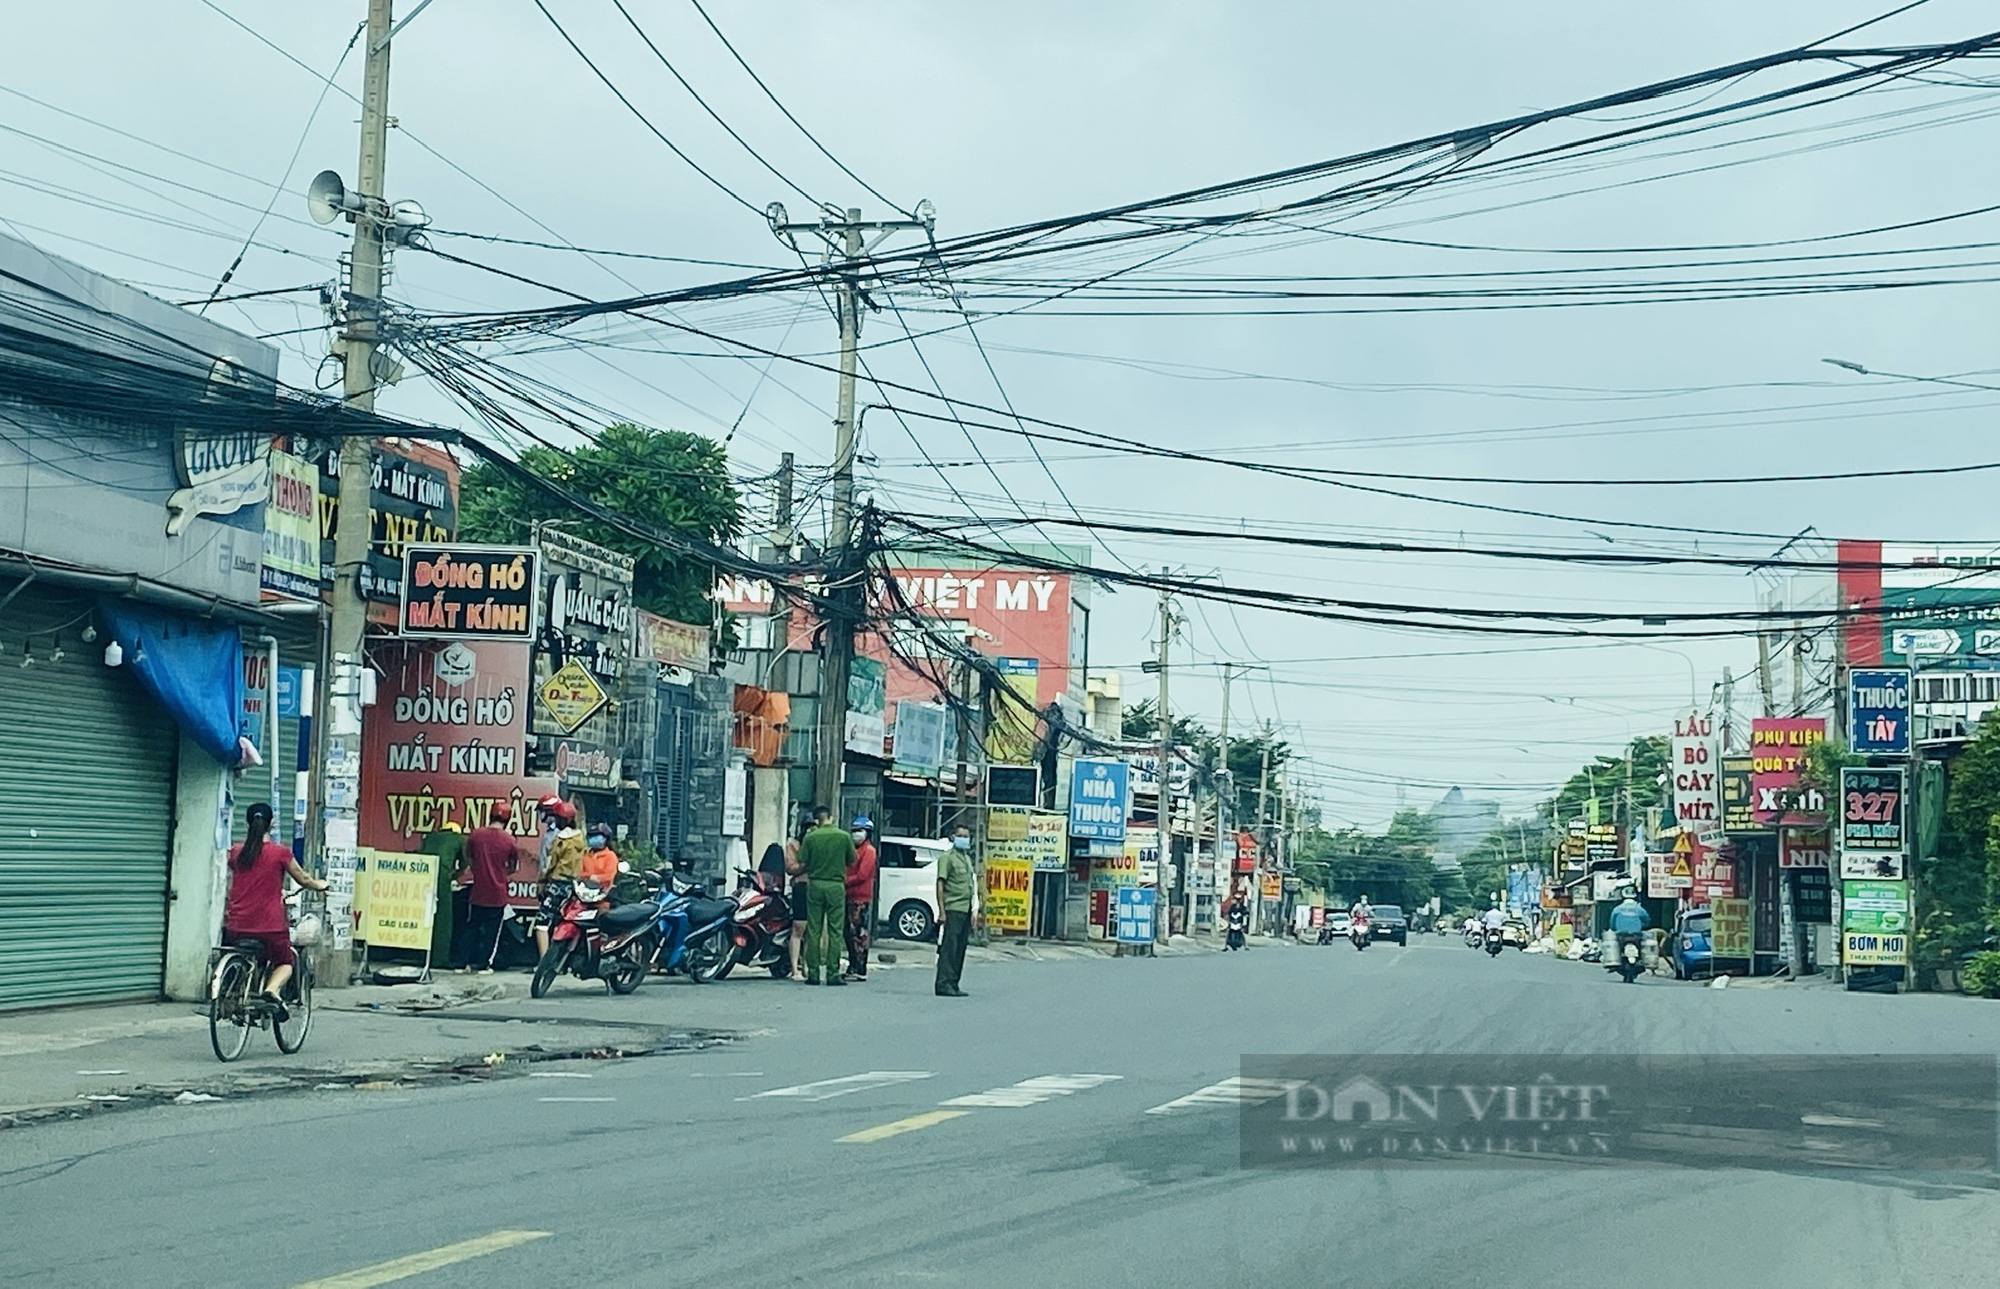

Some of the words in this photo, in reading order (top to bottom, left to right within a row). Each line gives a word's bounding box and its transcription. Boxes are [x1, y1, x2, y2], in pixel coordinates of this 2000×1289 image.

[391, 462, 416, 500] MẮT
[417, 473, 445, 509] KÍNH
[415, 552, 484, 589] ĐỒNG
[489, 554, 527, 591] HỒ
[898, 573, 985, 614] VIỆT
[995, 574, 1057, 612] MỸ
[408, 590, 461, 629] MẮT
[465, 597, 528, 631] KÍNH
[602, 591, 628, 634] CÁO
[395, 686, 469, 725] ĐỒNG
[475, 687, 515, 726] HỒ
[1856, 677, 1906, 709] THUỐC
[1754, 730, 1784, 748] PHỤ
[1865, 714, 1898, 742] TÂY
[388, 733, 443, 772] MẮT
[450, 738, 516, 775] KÍNH
[1683, 741, 1709, 765] BÒ
[1753, 756, 1783, 774] QUÀ
[1082, 777, 1116, 799] NHÀ
[1676, 769, 1715, 791] CÂY
[387, 783, 455, 839] VIỆT
[1073, 800, 1122, 824] THUỐC
[1678, 797, 1715, 820] MÍT
[1845, 792, 1899, 821] 327
[377, 858, 407, 875] NHẬN
[409, 858, 430, 873] SỬA
[1848, 936, 1878, 951] BƠM
[1882, 937, 1903, 952] HƠI
